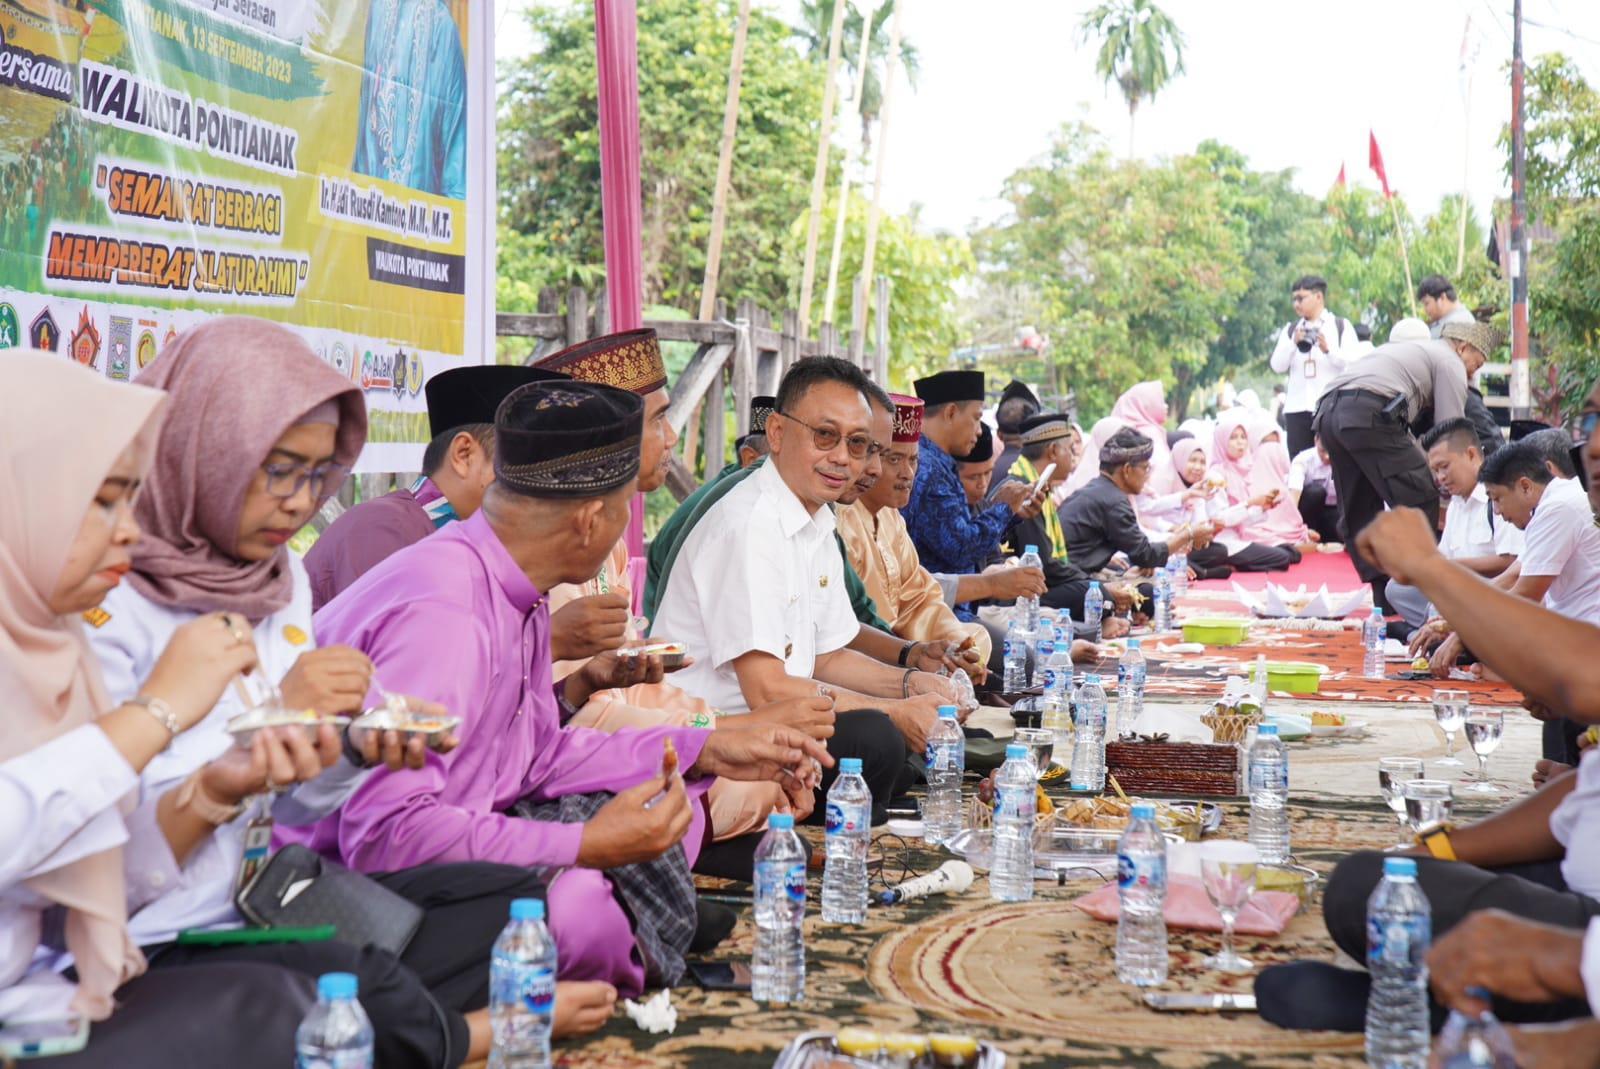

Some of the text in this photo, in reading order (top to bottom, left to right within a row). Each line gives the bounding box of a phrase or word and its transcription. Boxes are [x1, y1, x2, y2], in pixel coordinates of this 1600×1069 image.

[130, 0, 293, 84] TIANAK, 13 SEPTEMBER 2023
[0, 51, 73, 95] ersama
[82, 67, 296, 170] WALIKOTA PONTIANAK
[213, 184, 282, 236] BERBAGI
[350, 188, 376, 221] Rusdi
[431, 209, 450, 239] M.T.
[46, 231, 195, 290] MEMPERERAT
